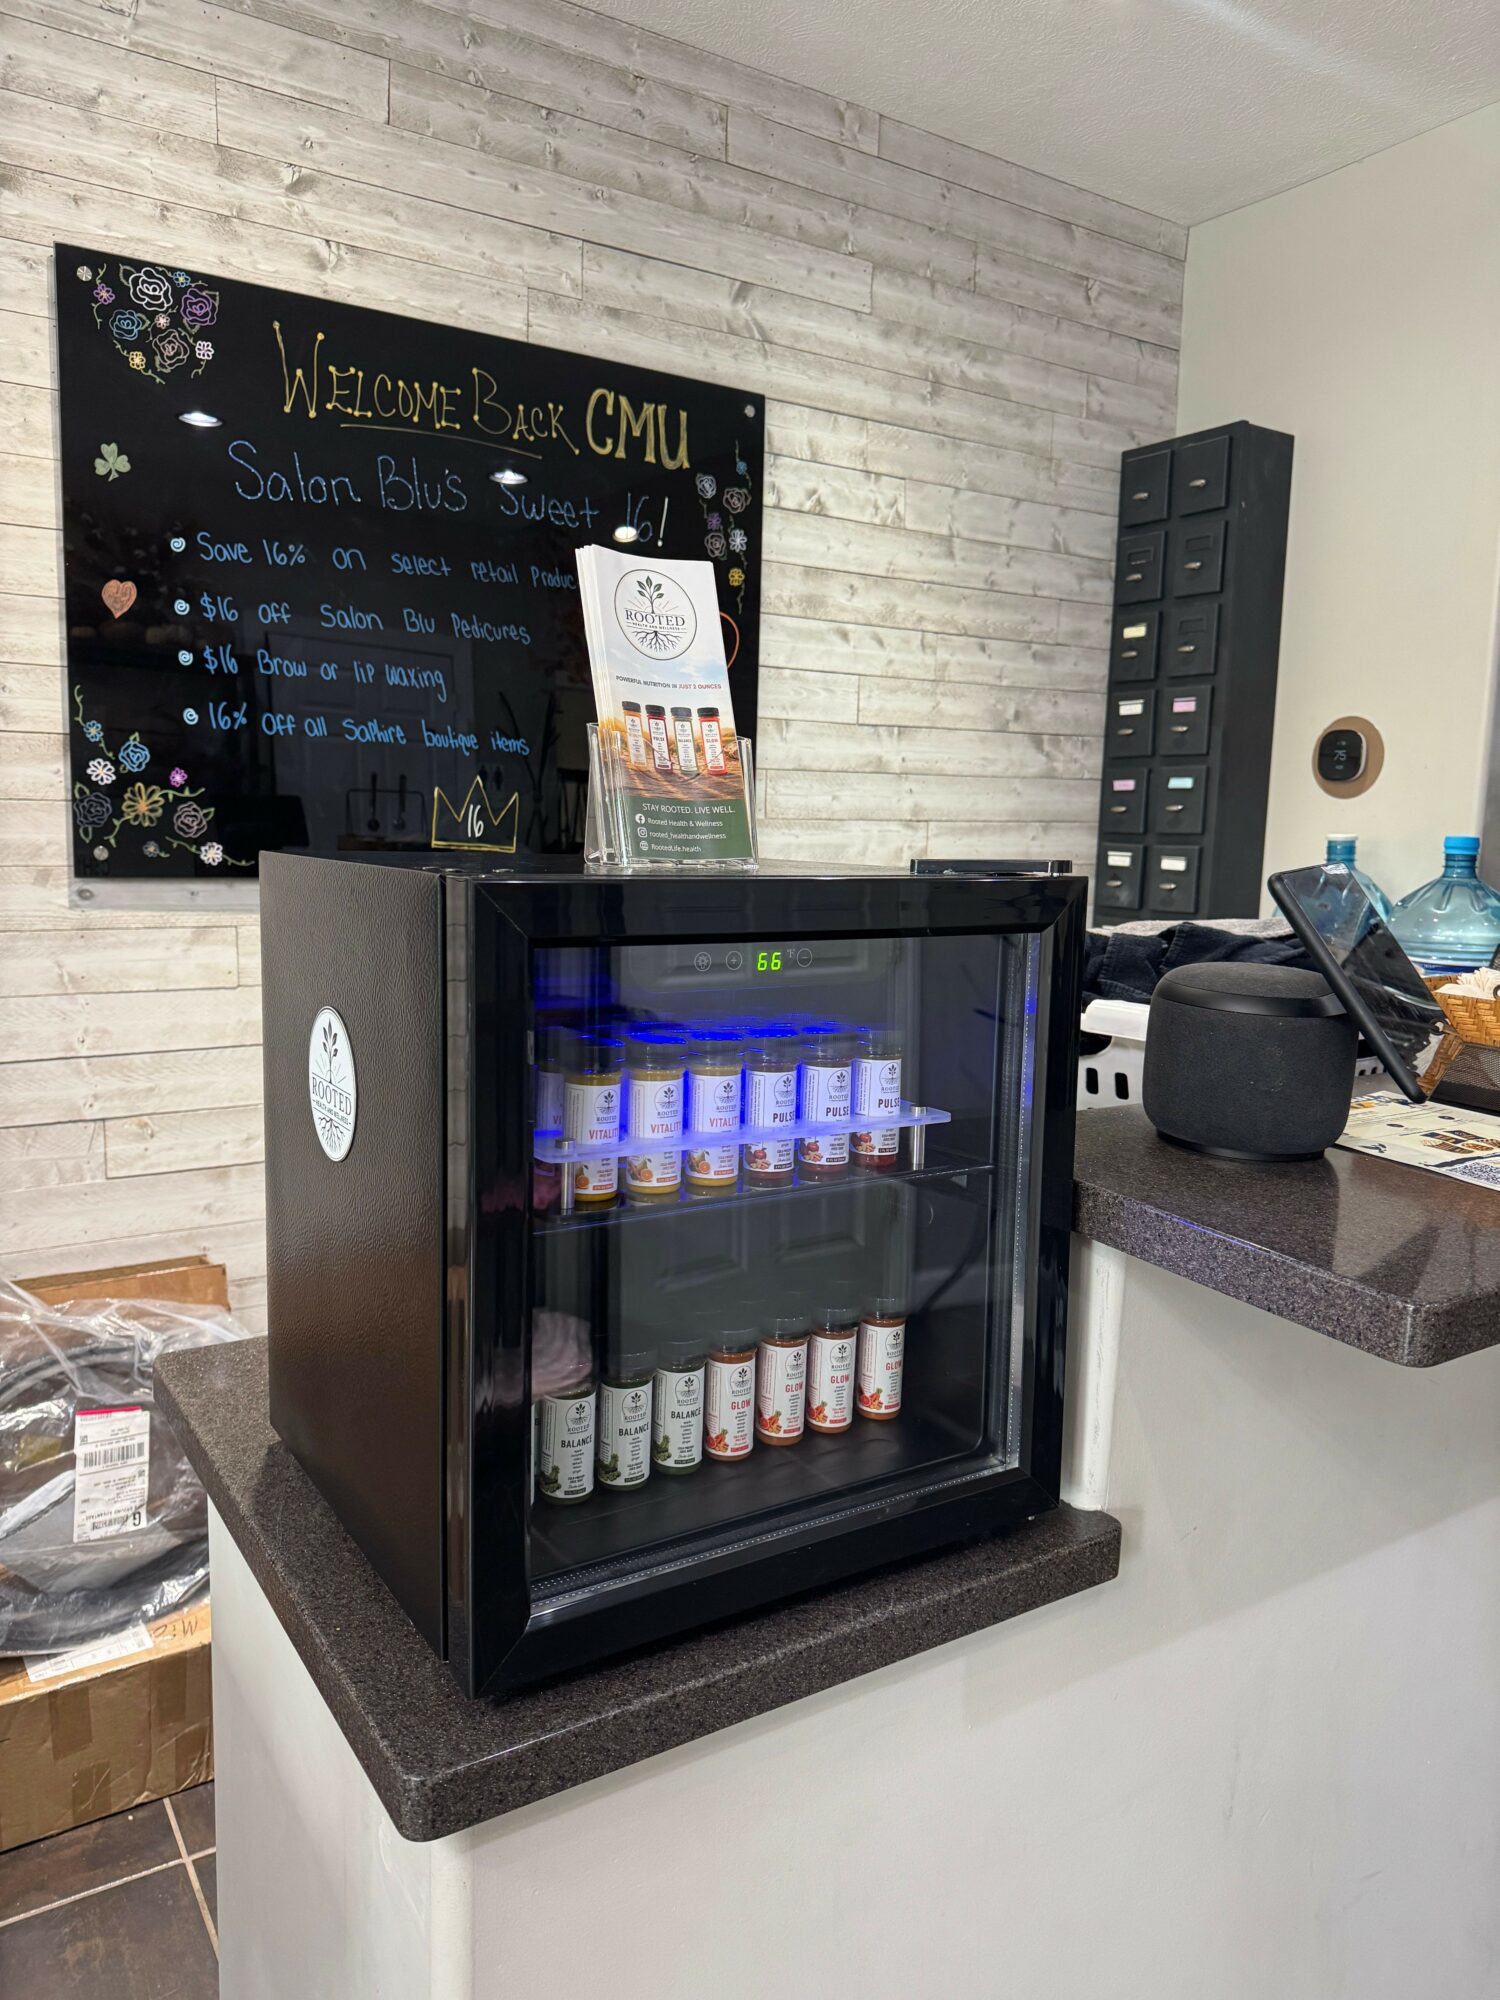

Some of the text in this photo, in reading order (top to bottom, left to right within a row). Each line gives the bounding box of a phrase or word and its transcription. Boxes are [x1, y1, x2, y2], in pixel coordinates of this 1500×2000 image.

[273, 320, 462, 430] WELCOME
[586, 388, 690, 471] CMU
[228, 440, 362, 505] Salon
[500, 483, 600, 529] Sweet
[197, 531, 253, 563] Save
[262, 539, 306, 567] 16%
[332, 548, 367, 570] on
[471, 561, 519, 584] retail
[531, 566, 577, 589] Produc
[200, 592, 238, 622] $16
[320, 603, 384, 630] Salon
[403, 608, 435, 633] Blu
[451, 612, 531, 645] Pedicures
[625, 609, 686, 627] ROOTED
[203, 643, 238, 675] $16
[256, 649, 307, 677] Brow
[320, 662, 338, 680] or
[385, 663, 446, 704] waxing
[616, 675, 642, 685] POWERFUL
[643, 680, 671, 688] NUTRITION
[209, 702, 247, 731] 16%
[304, 716, 328, 737] all
[421, 719, 479, 757] boutique
[490, 730, 530, 756] items
[642, 803, 659, 812] STAY
[694, 806, 711, 814] LIVE
[711, 806, 736, 814] WELL.
[467, 804, 484, 838] 16
[647, 817, 668, 826] Rooted
[757, 952, 782, 971] 66
[312, 1077, 352, 1116] ROOTED
[878, 1097, 900, 1109] PULSE
[825, 1105, 849, 1117] PULSE
[830, 1374, 849, 1384] GLOW
[785, 1381, 804, 1393] GLOW
[731, 1398, 752, 1410] GLOW
[670, 1406, 702, 1420] BALANCE
[618, 1422, 650, 1437] BALANCE
[560, 1434, 593, 1448] BALANCE
[132, 1511, 142, 1527] G
